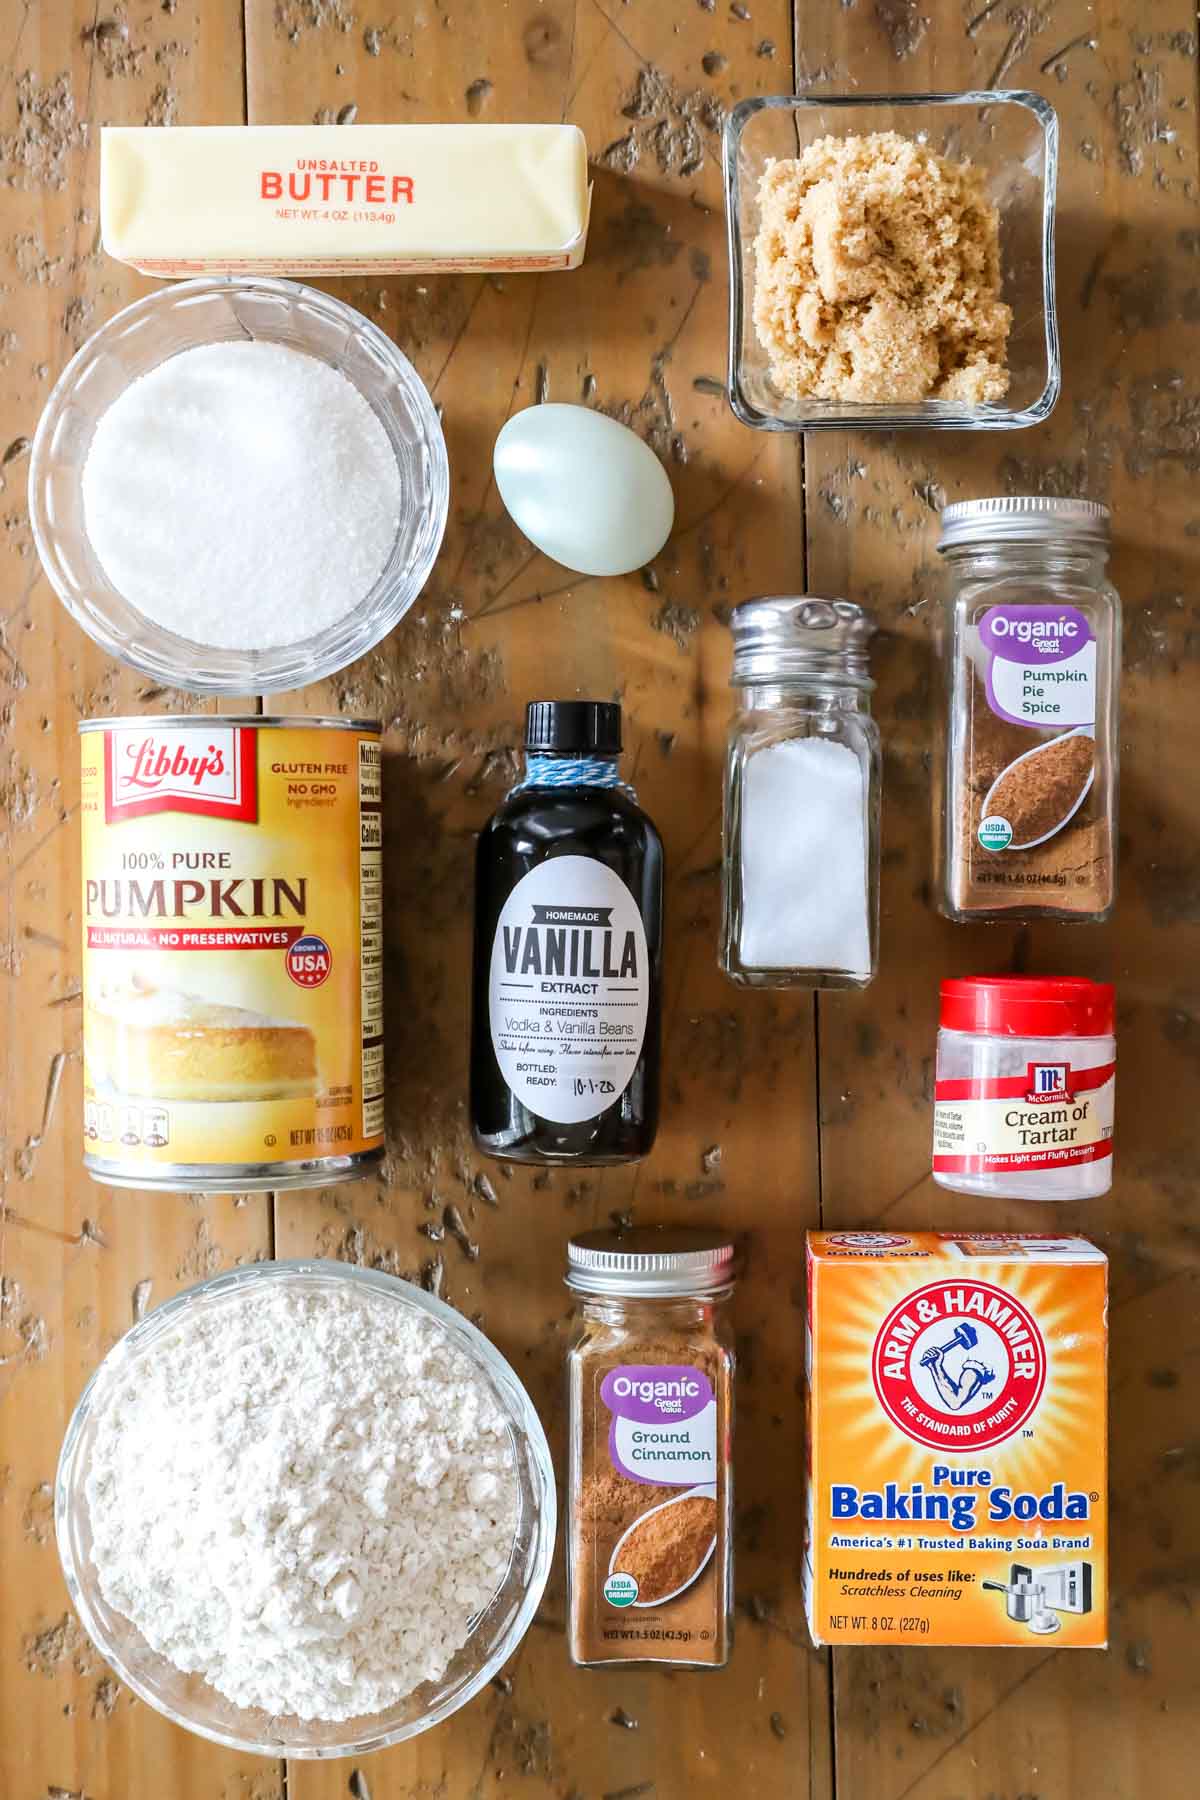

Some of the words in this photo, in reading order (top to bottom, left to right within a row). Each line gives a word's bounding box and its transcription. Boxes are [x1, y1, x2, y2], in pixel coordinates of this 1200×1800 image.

[297, 160, 379, 172] UNSALTED
[261, 172, 416, 204] BUTTER
[276, 208, 300, 219] NET
[332, 210, 349, 221] OZ
[991, 616, 1079, 642] Organic
[1032, 639, 1060, 648] Great
[1023, 670, 1088, 684] Pumpkin
[1023, 686, 1045, 697] Pie
[1022, 702, 1061, 715] Spice
[120, 738, 225, 788] Libby's
[271, 763, 322, 774] GLUTEN
[325, 763, 348, 775] FREE
[288, 784, 308, 795] NO
[311, 784, 337, 795] GMO
[985, 823, 1005, 832] USDA
[121, 853, 165, 869] 100%
[172, 853, 231, 868] PURE
[86, 878, 307, 918] PUMPKIN
[546, 911, 600, 921] HOMEMADE
[104, 932, 150, 945] NATURAL
[159, 933, 180, 945] NO
[182, 932, 289, 945] PRESERVATIVES
[503, 926, 638, 978] VANILLA
[292, 955, 328, 972] USA
[541, 982, 599, 995] EXTRACT
[540, 1007, 599, 1018] INGREDIENTS
[505, 1016, 540, 1032] Vodka
[544, 1021, 553, 1032] &
[556, 1021, 596, 1035] Vanilla
[599, 1022, 634, 1035] Beans
[516, 1063, 558, 1074] BOTTLED:
[526, 1076, 558, 1087] READY:
[1028, 1087, 1070, 1103] McCormick
[1005, 1110, 1068, 1127] Cream
[1072, 1102, 1090, 1121] of
[1018, 1126, 1078, 1146] Tartar
[985, 1155, 1009, 1164] Makes
[1010, 1154, 1030, 1164] Light
[1031, 1153, 1047, 1162] and
[1047, 1150, 1069, 1160] Fluffy
[1069, 1146, 1096, 1157] Desserts
[883, 1313, 921, 1382] ARM
[915, 1299, 943, 1324] &
[943, 1289, 1036, 1381] HAMMER
[613, 1376, 700, 1402] Organic
[982, 1391, 994, 1400] TM
[654, 1398, 682, 1407] Great
[900, 1395, 918, 1418] THE
[915, 1412, 972, 1436] STANDARD
[973, 1421, 987, 1435] OF
[987, 1396, 1019, 1428] PURITY
[632, 1432, 691, 1444] Ground
[1022, 1430, 1034, 1438] TM
[632, 1448, 712, 1461] Cinnamon
[933, 1466, 992, 1487] Pure
[831, 1484, 977, 1530] Baking
[989, 1484, 1088, 1520] Soda
[831, 1536, 893, 1549] America's
[898, 1538, 912, 1549] #1
[918, 1538, 964, 1550] Trusted
[969, 1539, 1012, 1552] Baking
[1017, 1539, 1048, 1550] Soda
[1052, 1538, 1091, 1549] Brand
[828, 1568, 893, 1582] Hundreds
[896, 1569, 909, 1582] of
[914, 1573, 944, 1582] uses
[948, 1571, 976, 1583] like:
[610, 1580, 631, 1589] USDA
[607, 1591, 635, 1599] ORGANIC
[840, 1584, 906, 1598] Scratchless
[909, 1586, 963, 1601] Cleaning
[829, 1615, 849, 1630] NET
[852, 1616, 870, 1631] WT.
[871, 1617, 878, 1631] 8
[880, 1617, 897, 1632] OZ.
[899, 1617, 931, 1634] (227g)
[603, 1630, 619, 1640] NET
[621, 1630, 635, 1640] WT
[649, 1630, 661, 1640] OZ
